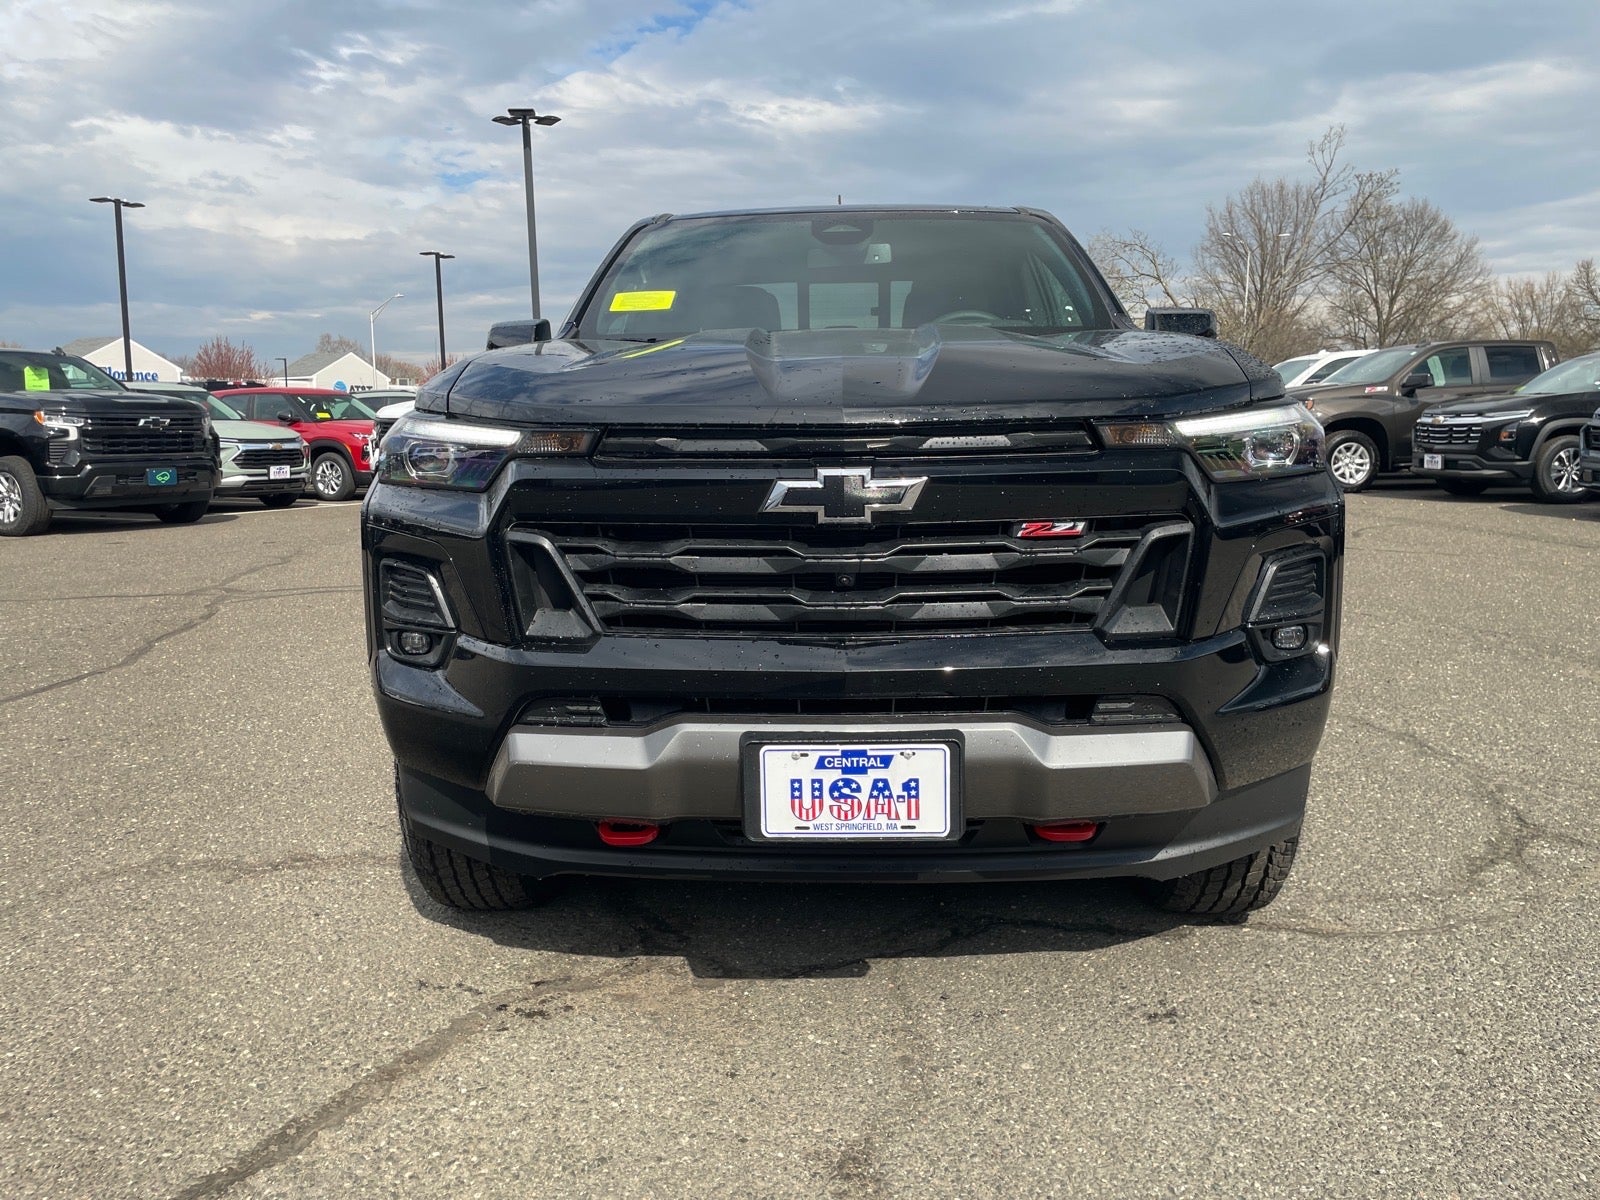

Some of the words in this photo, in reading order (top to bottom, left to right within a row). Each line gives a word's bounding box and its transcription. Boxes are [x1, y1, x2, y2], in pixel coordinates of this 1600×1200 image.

[1017, 522, 1086, 536] Z71
[824, 757, 884, 768] CENTRAL
[790, 778, 920, 821] USA-1
[813, 823, 833, 831] WEST
[835, 823, 884, 832] SPRINGFIELD,
[886, 823, 898, 831] MA
